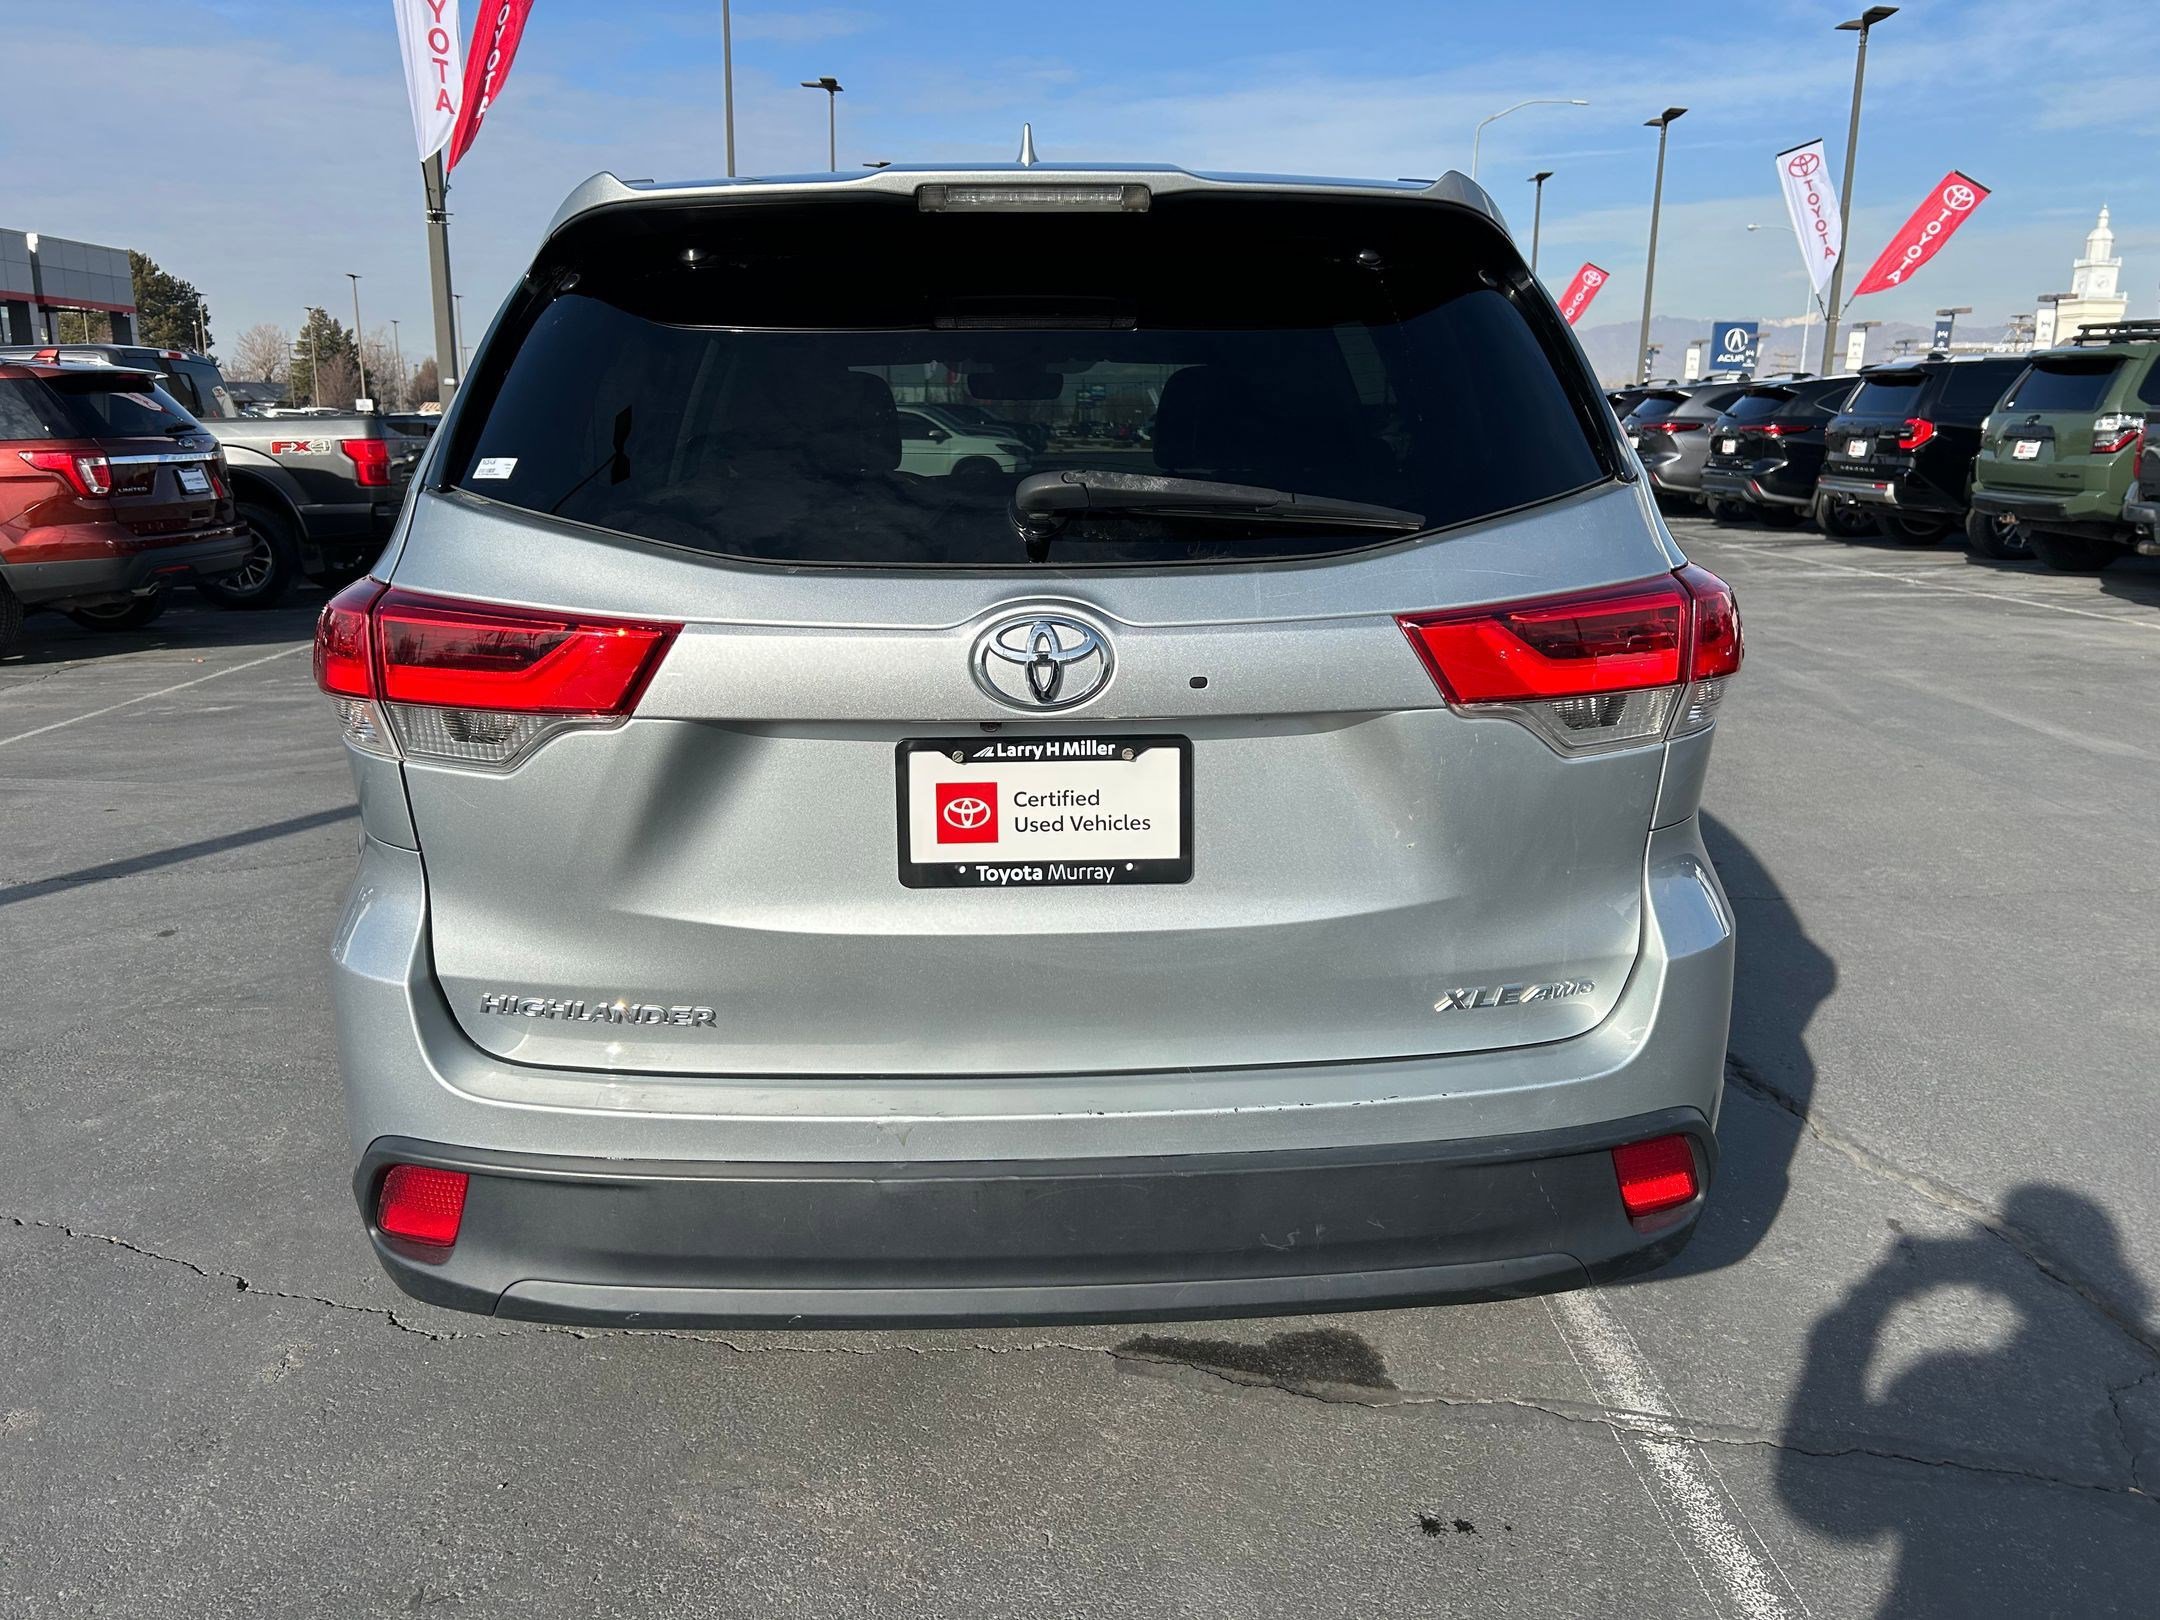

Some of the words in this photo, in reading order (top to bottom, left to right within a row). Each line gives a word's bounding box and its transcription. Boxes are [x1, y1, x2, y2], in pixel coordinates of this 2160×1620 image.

[475, 0, 510, 119] OYOTA
[1804, 179, 1836, 260] TOYOTA
[1888, 208, 1953, 285] TOYOTA
[1716, 353, 1745, 363] ACUR
[271, 440, 331, 455] FX4
[997, 742, 1044, 760] Larry
[1046, 741, 1061, 756] H
[1062, 740, 1116, 756] Miller
[1013, 789, 1101, 808] Certified
[1014, 815, 1065, 833] Used
[1069, 814, 1151, 832] Vehicles
[975, 864, 1043, 885] Toyota
[1047, 863, 1115, 884] Murray
[1433, 982, 1523, 1012] XLE
[1519, 978, 1597, 1003] AWD
[479, 992, 718, 1028] HIGHLANDER
